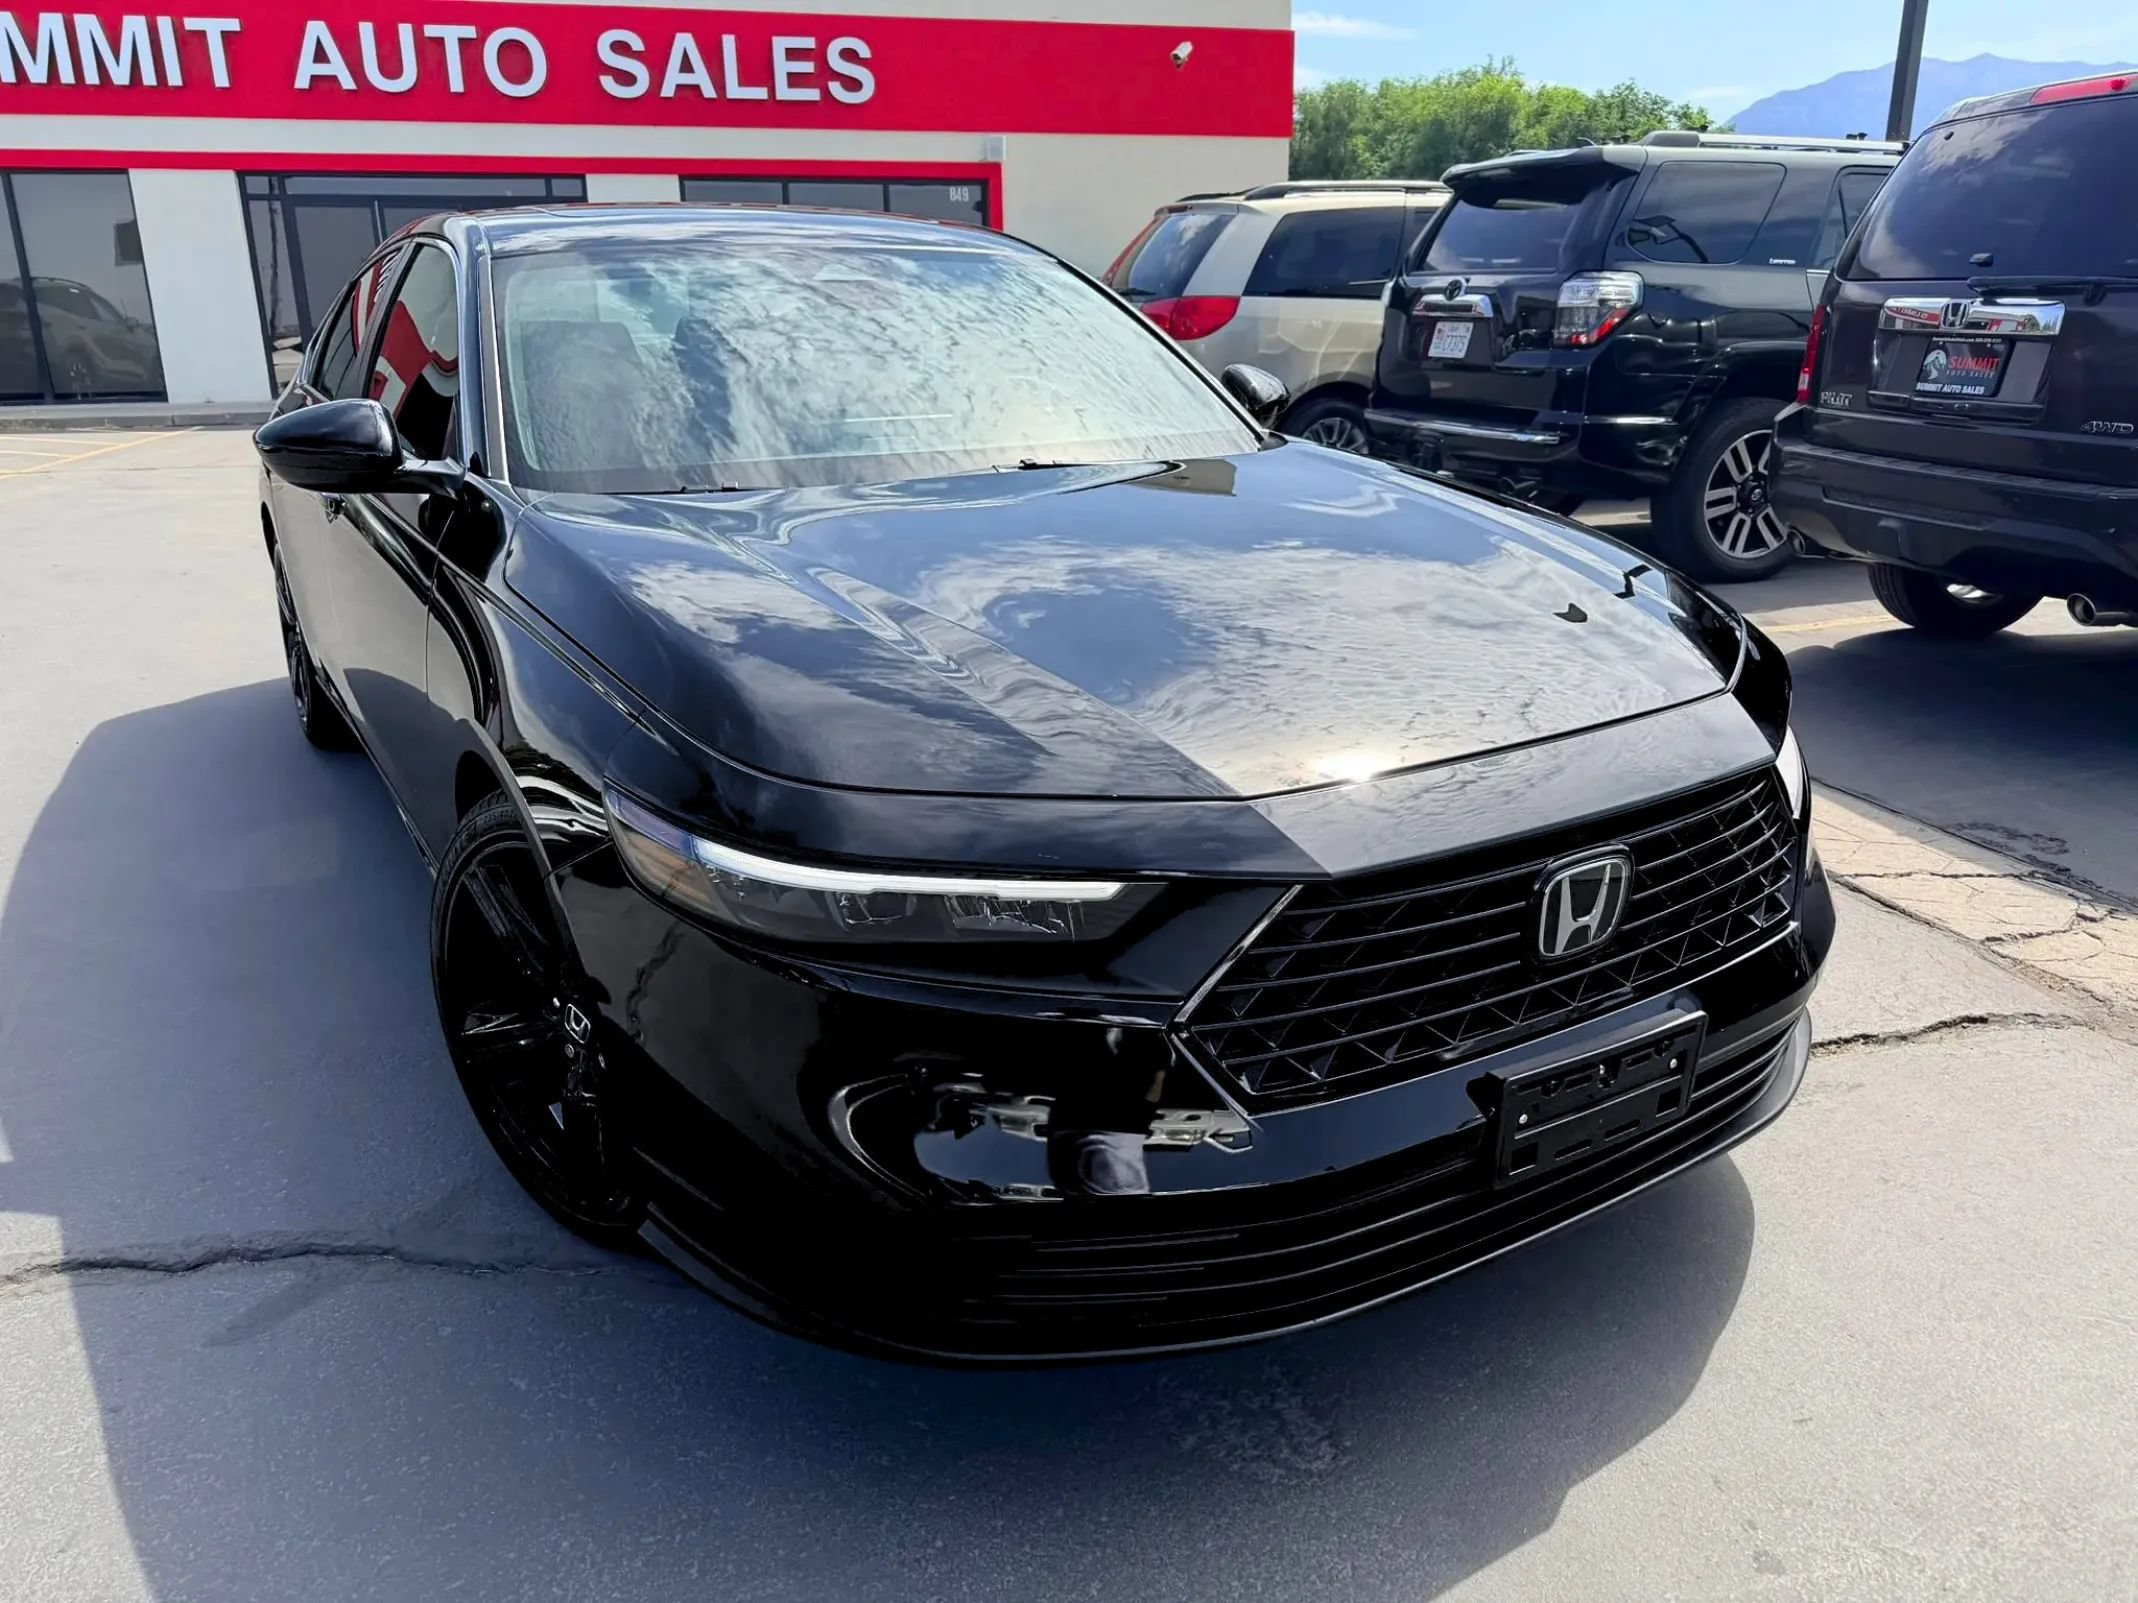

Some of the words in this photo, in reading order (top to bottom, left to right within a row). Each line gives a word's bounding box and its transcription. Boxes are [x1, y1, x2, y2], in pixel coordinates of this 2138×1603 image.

[0, 11, 240, 87] MMIT
[295, 20, 548, 97] AUTO
[598, 29, 876, 104] SALES
[949, 187, 969, 202] 849
[1948, 356, 2000, 371] SUMMIT
[1916, 382, 1943, 392] SUMMIT
[1942, 384, 1962, 394] AUTO
[1962, 385, 1985, 395] SALES
[2079, 420, 2134, 433] 4WD
